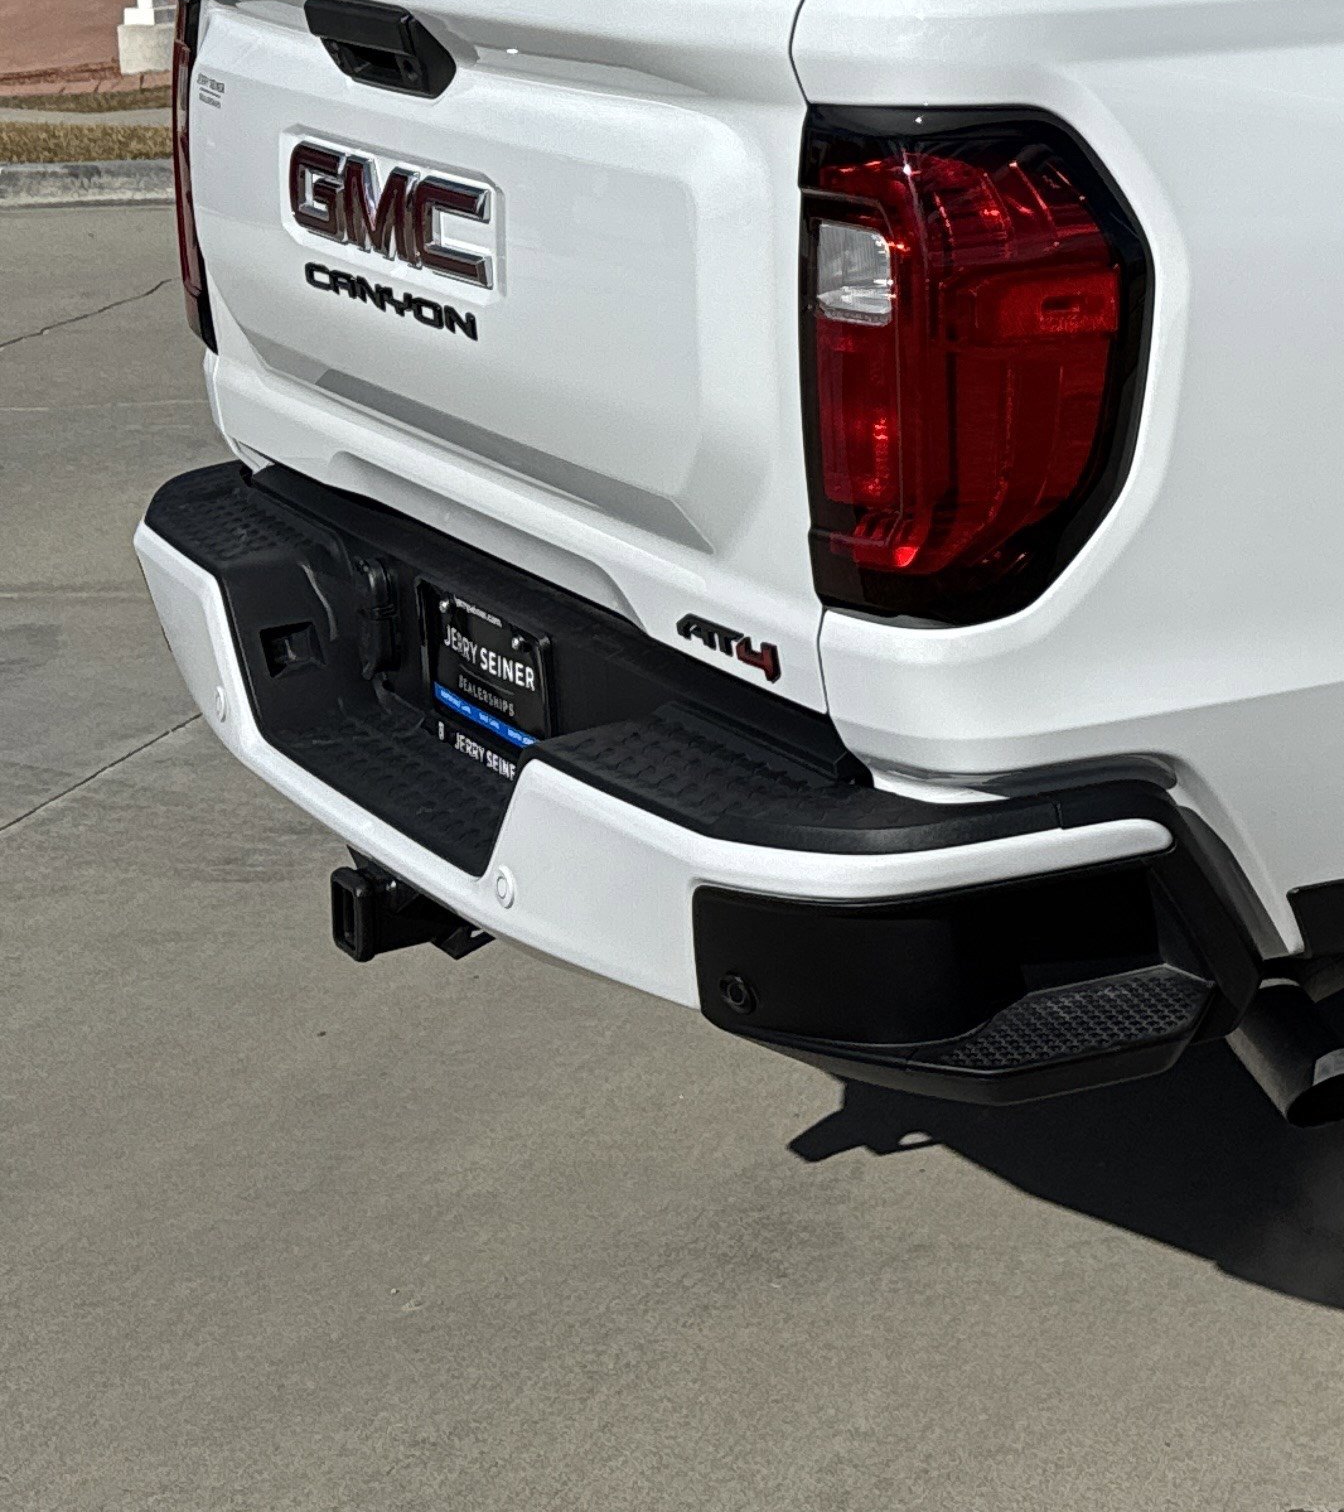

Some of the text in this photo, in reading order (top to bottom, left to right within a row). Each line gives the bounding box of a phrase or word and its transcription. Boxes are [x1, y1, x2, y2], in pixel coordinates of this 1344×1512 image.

[289, 140, 493, 290] GMC
[304, 261, 479, 342] CANYON
[443, 624, 536, 692] JERRY SEINER
[675, 612, 782, 684] AT4
[454, 732, 517, 781] JERRY SEINE
